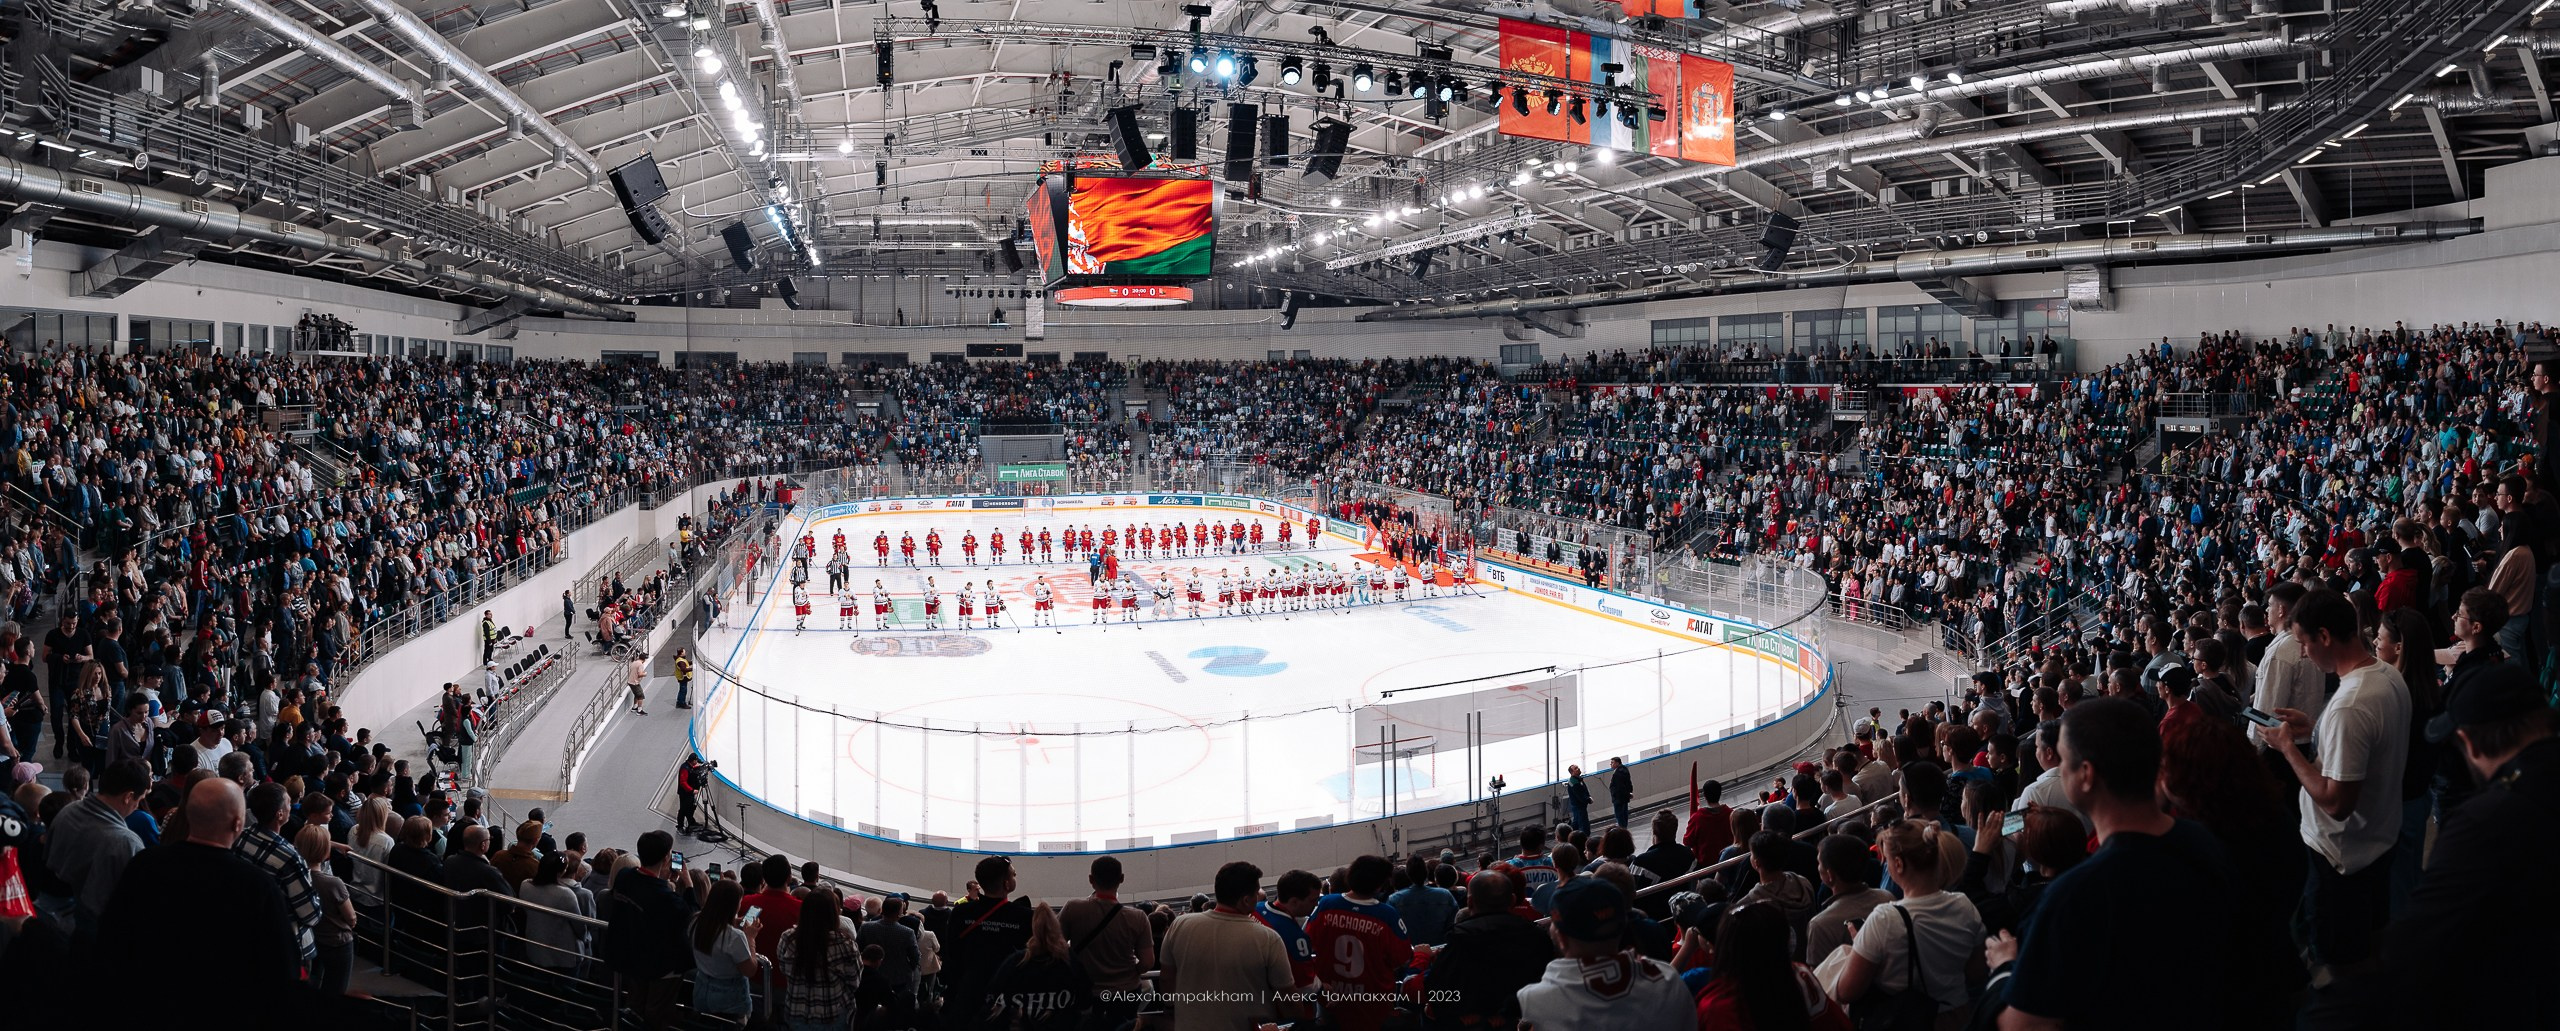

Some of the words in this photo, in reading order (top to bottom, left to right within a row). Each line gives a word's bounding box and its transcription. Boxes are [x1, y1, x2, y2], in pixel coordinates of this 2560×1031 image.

[1122, 288, 1129, 296] 0
[1149, 288, 1156, 296] 0
[2210, 421, 2219, 430] 10
[1492, 569, 1506, 582] ВТБ
[1296, 937, 1310, 957] 9
[1333, 934, 1365, 979] 9
